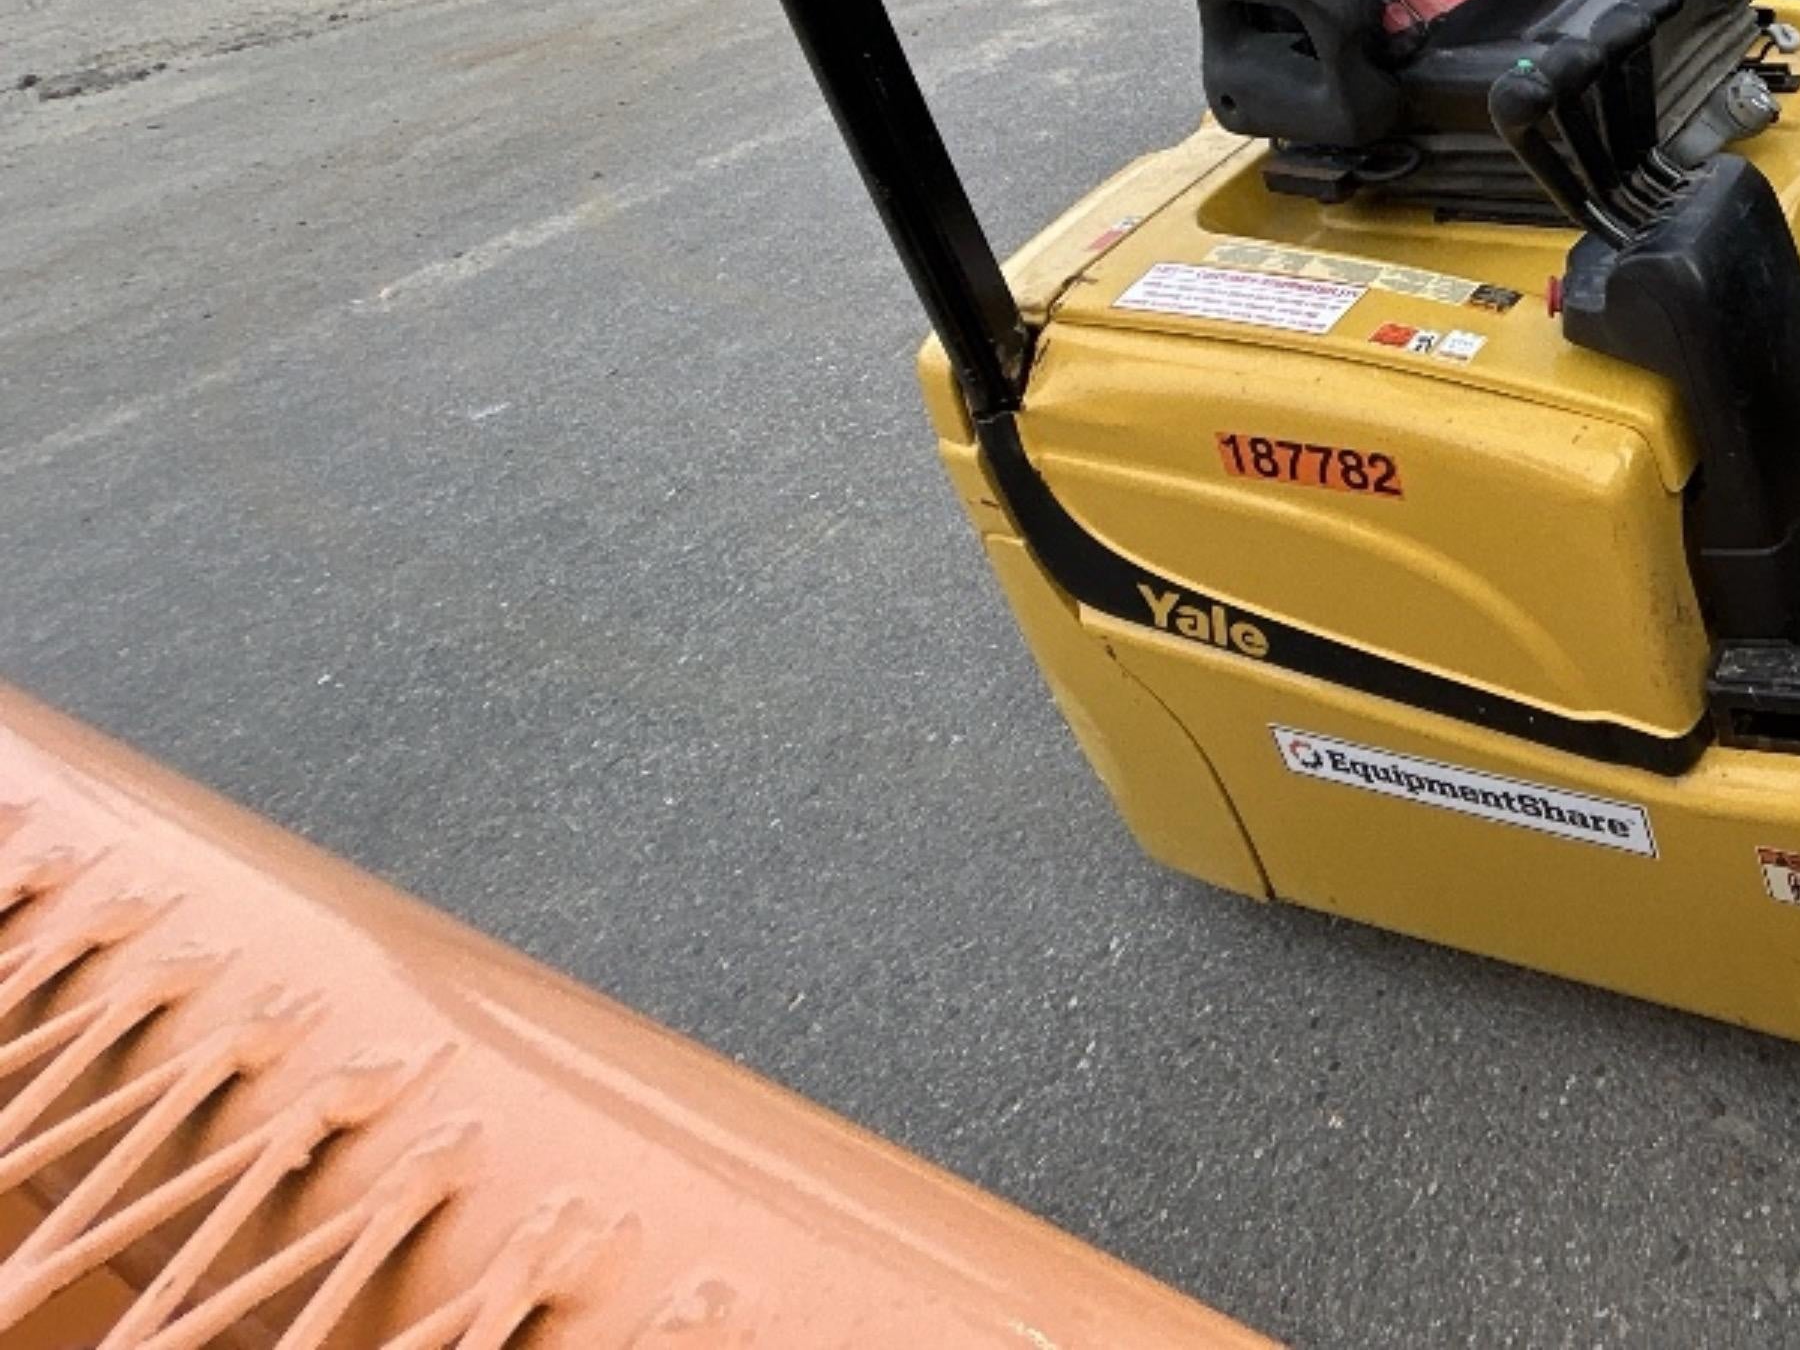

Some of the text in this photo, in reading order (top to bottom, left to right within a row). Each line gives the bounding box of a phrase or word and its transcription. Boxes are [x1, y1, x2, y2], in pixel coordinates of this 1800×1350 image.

[1221, 434, 1402, 497] 187782
[1136, 582, 1269, 659] Yale
[1325, 749, 1632, 839] EquipmentShare
